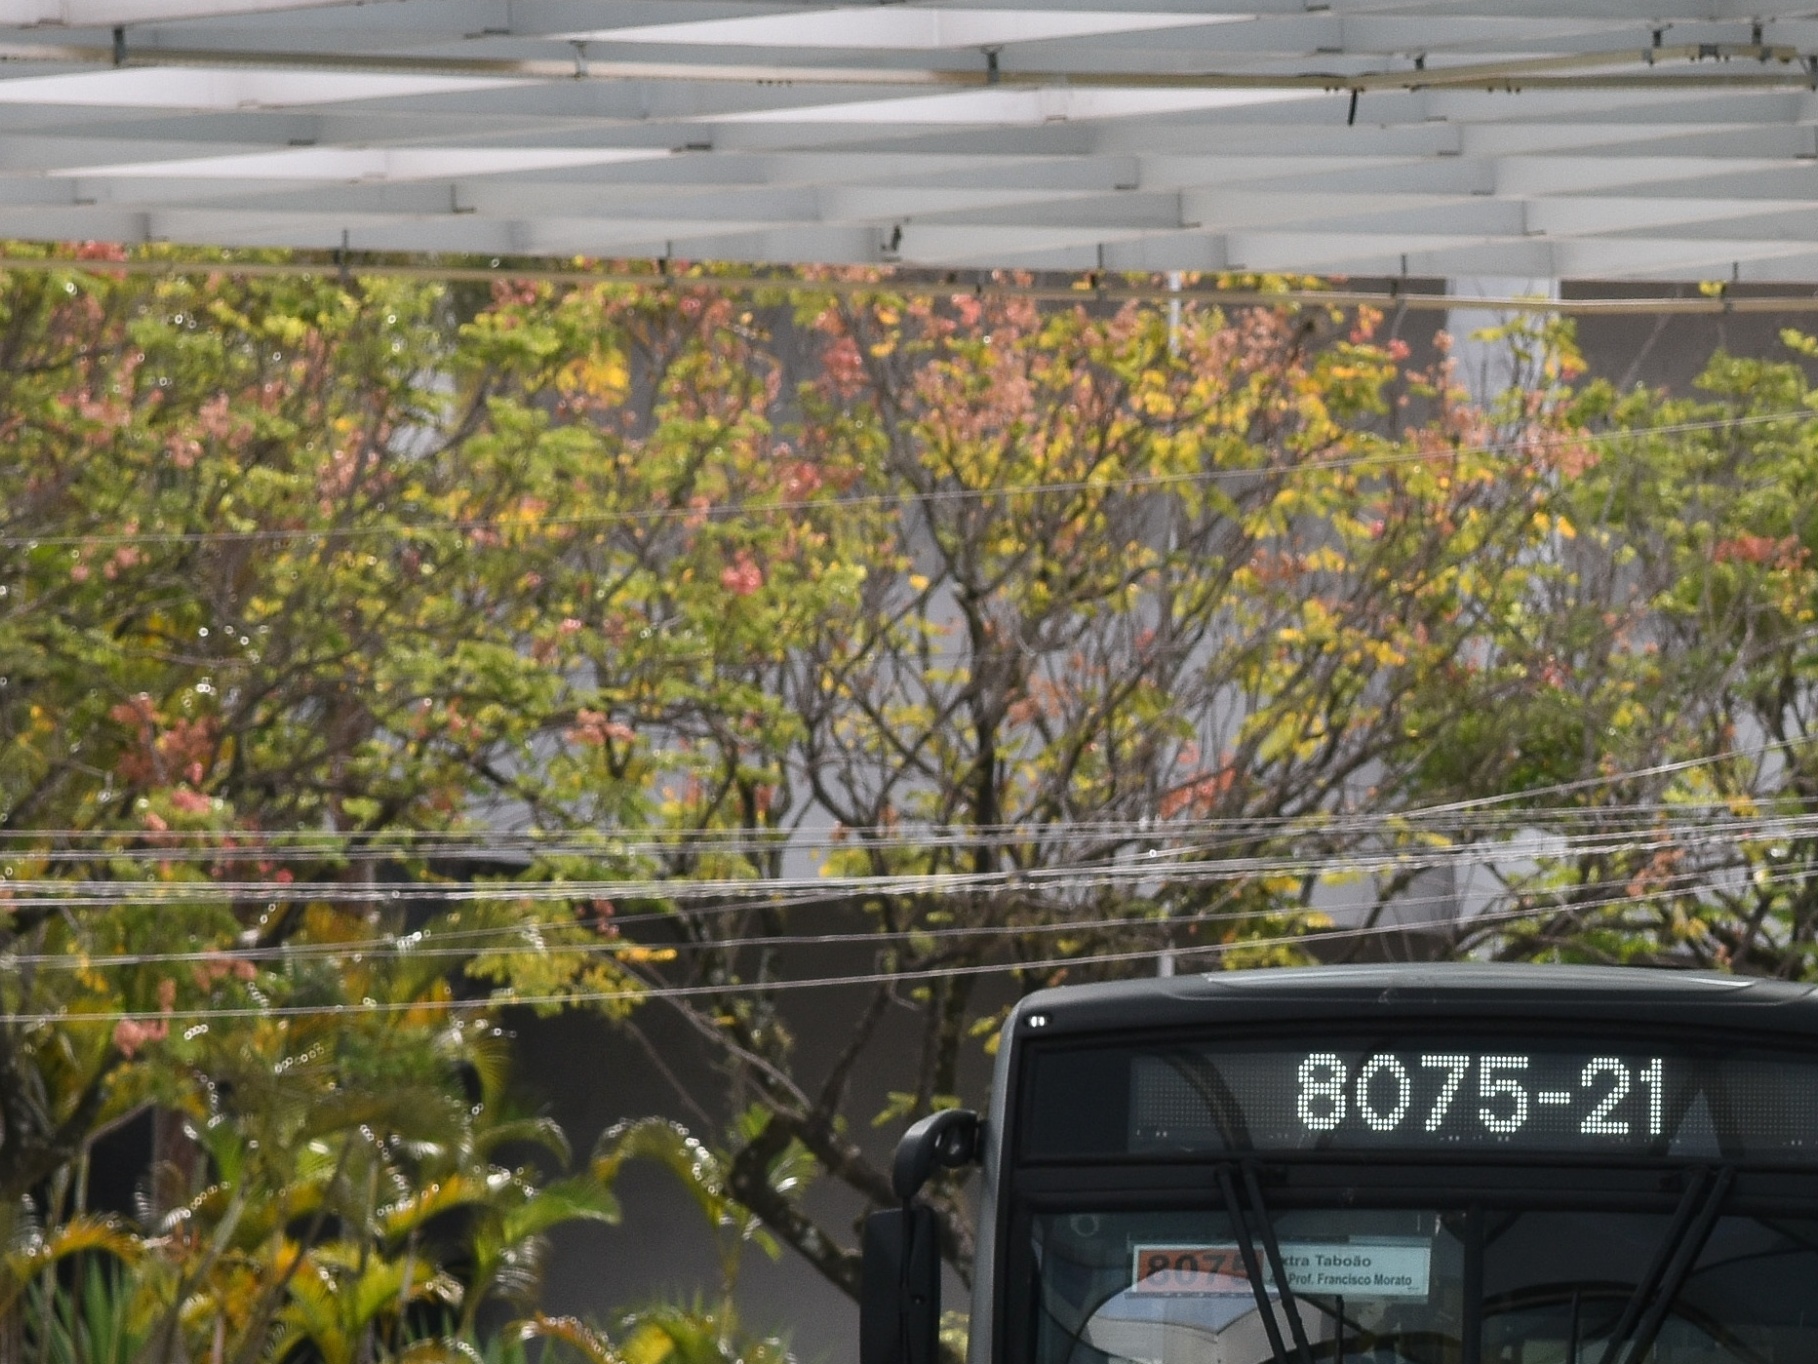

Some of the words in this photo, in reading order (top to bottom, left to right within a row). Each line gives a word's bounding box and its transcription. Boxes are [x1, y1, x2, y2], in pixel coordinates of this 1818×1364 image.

[1298, 1053, 1662, 1134] 8075-21
[1281, 1255, 1310, 1268] xtra
[1315, 1254, 1371, 1268] Taboão
[1288, 1273, 1315, 1287] Prof.
[1317, 1273, 1372, 1287] Francisco
[1374, 1274, 1412, 1287] Morato
